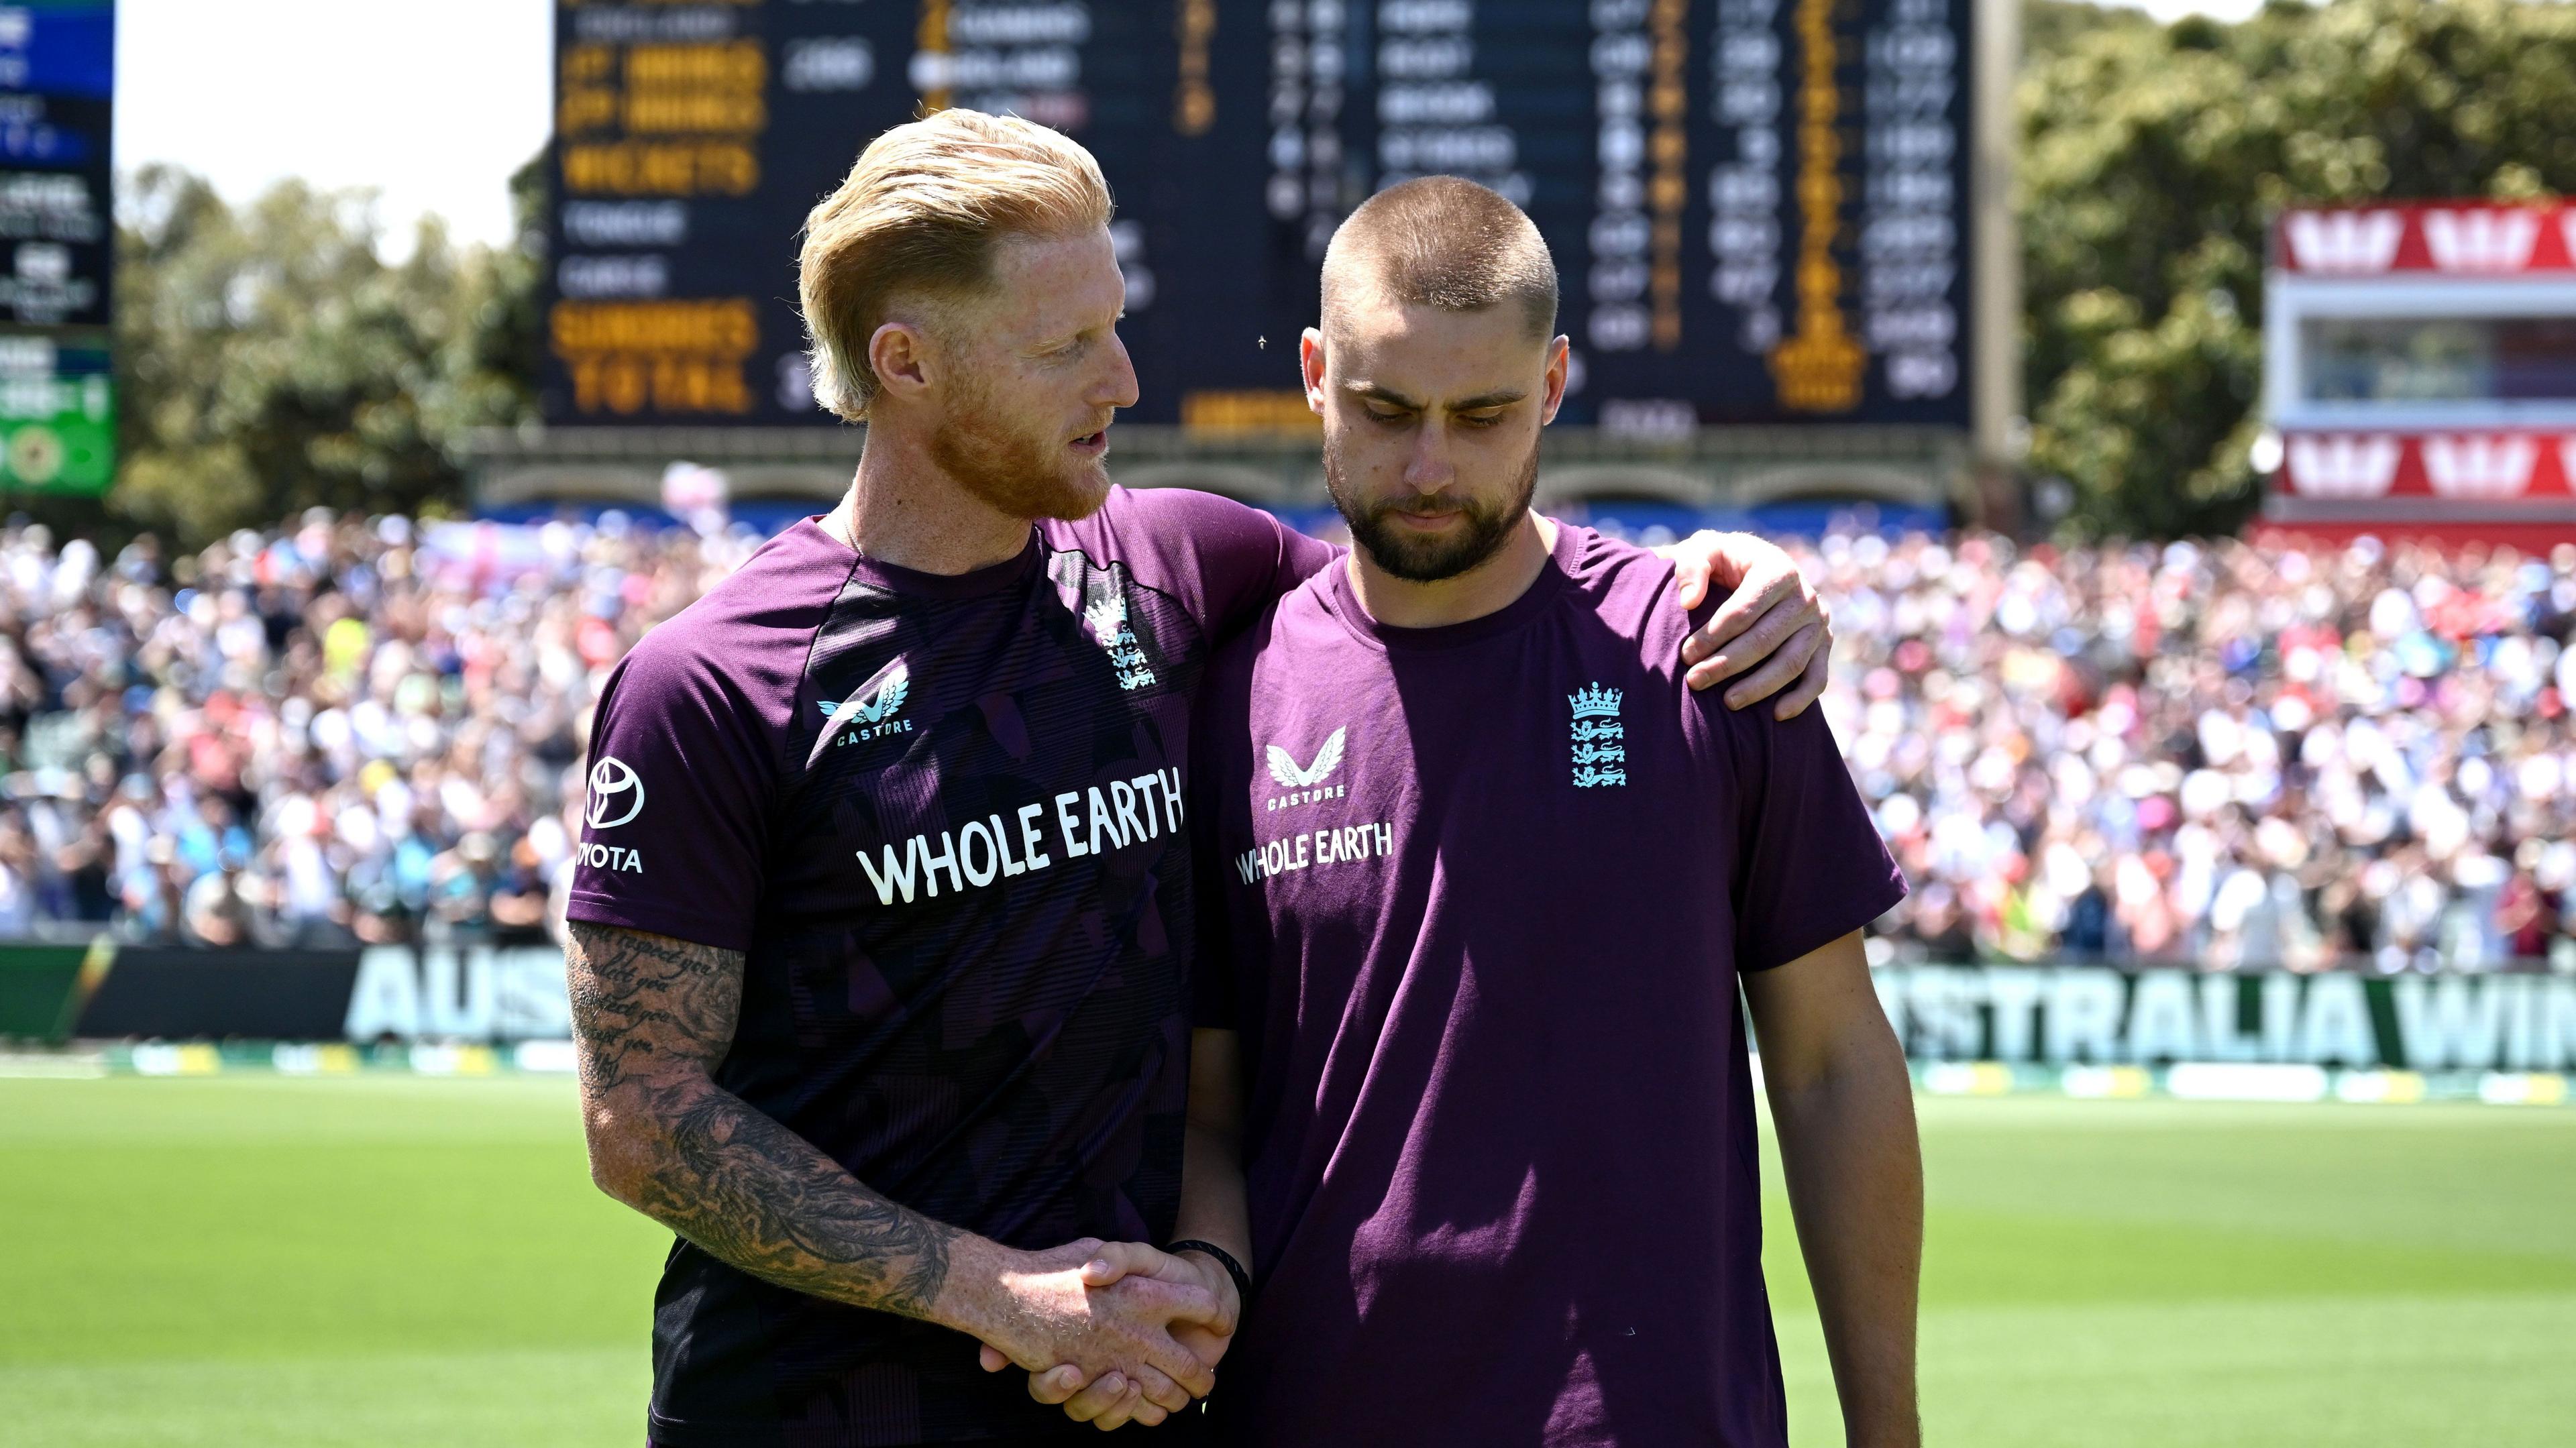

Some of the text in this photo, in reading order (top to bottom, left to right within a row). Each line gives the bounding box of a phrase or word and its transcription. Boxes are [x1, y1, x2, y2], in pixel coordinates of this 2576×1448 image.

[837, 719, 913, 747] CASTORE
[1267, 784, 1345, 812] CASTORE
[577, 842, 643, 874] OYOTA
[855, 766, 1184, 905] WHOLE EARTH
[1236, 822, 1393, 885] WHOLE EARTH
[1876, 967, 2381, 1065] STRALIA
